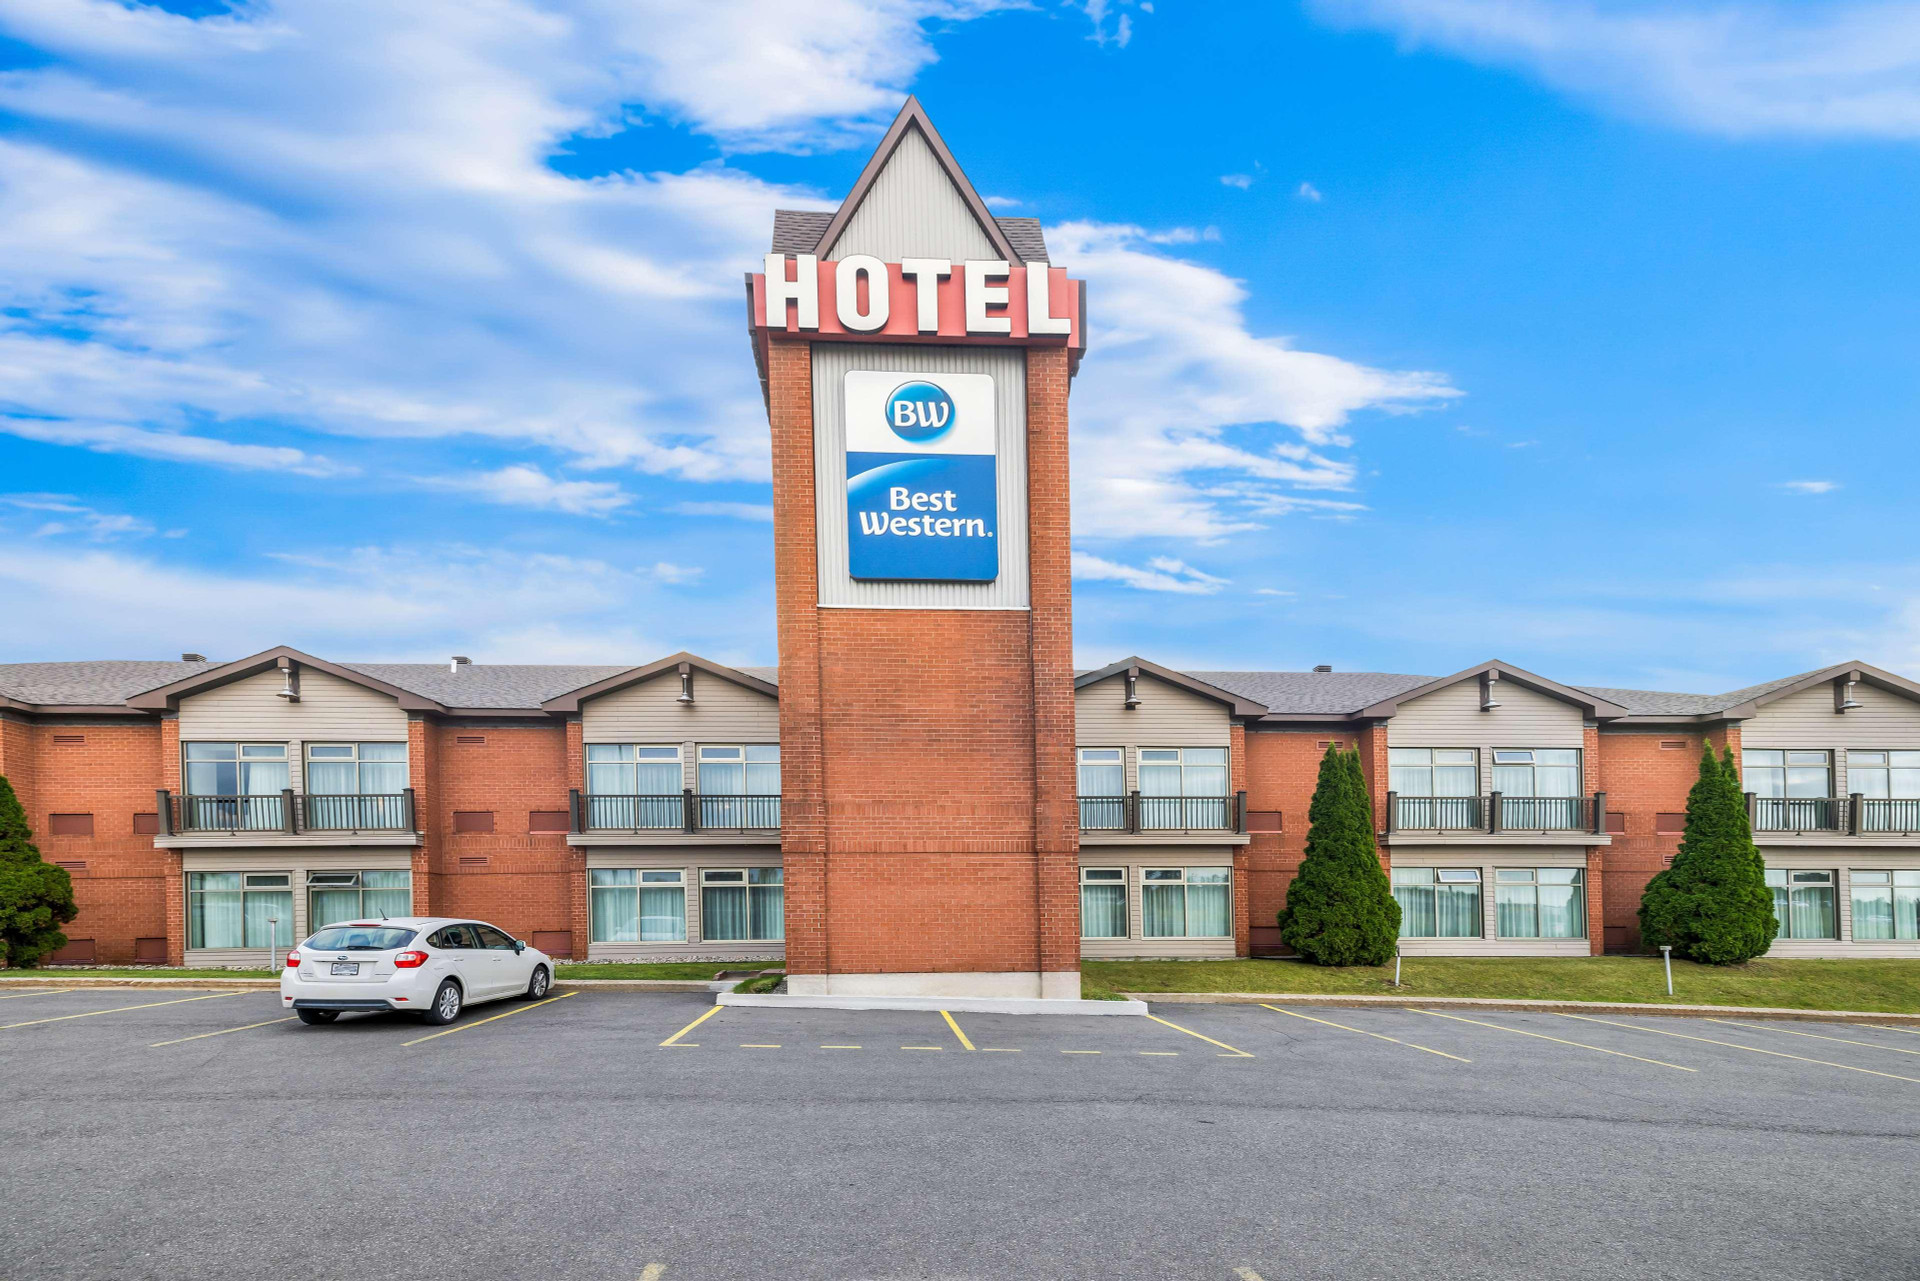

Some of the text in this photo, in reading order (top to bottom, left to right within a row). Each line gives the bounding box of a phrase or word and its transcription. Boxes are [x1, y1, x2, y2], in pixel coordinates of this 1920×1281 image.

[765, 253, 1072, 336] HOTEL
[893, 400, 950, 428] BW
[889, 486, 957, 512] Best
